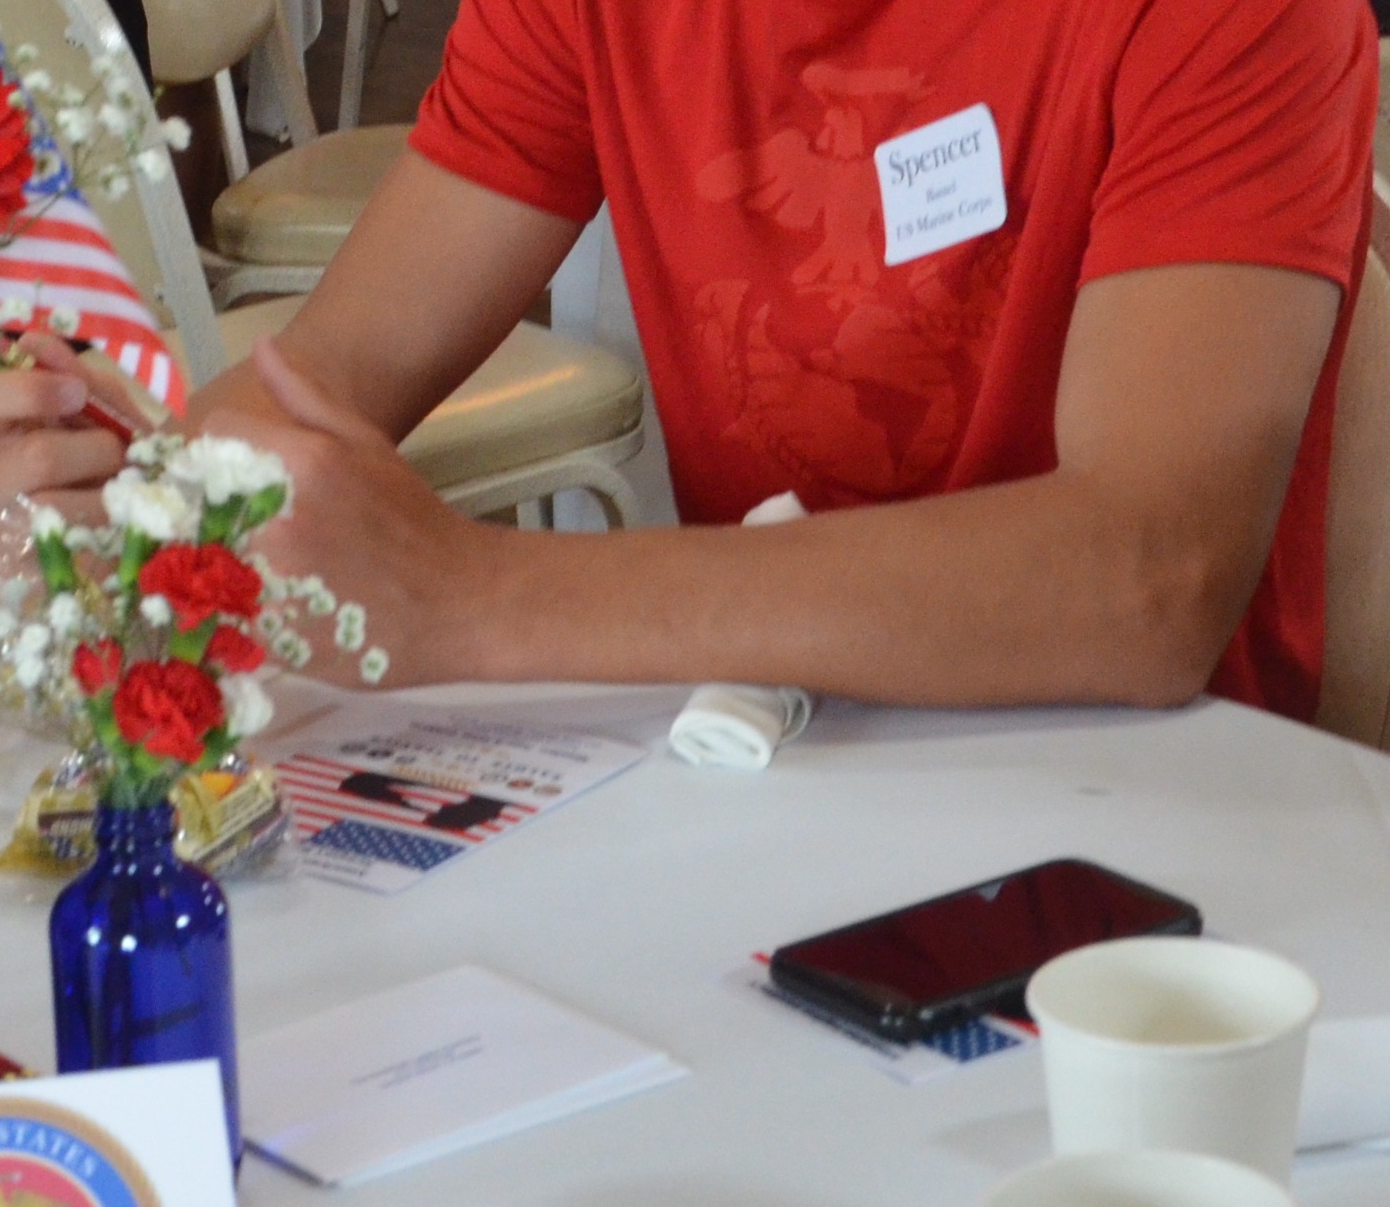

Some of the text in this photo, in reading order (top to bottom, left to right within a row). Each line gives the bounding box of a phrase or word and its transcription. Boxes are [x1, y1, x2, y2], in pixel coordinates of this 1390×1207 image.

[888, 128, 982, 187] Spencer
[916, 209, 955, 233] Marine
[957, 196, 993, 218] Corps
